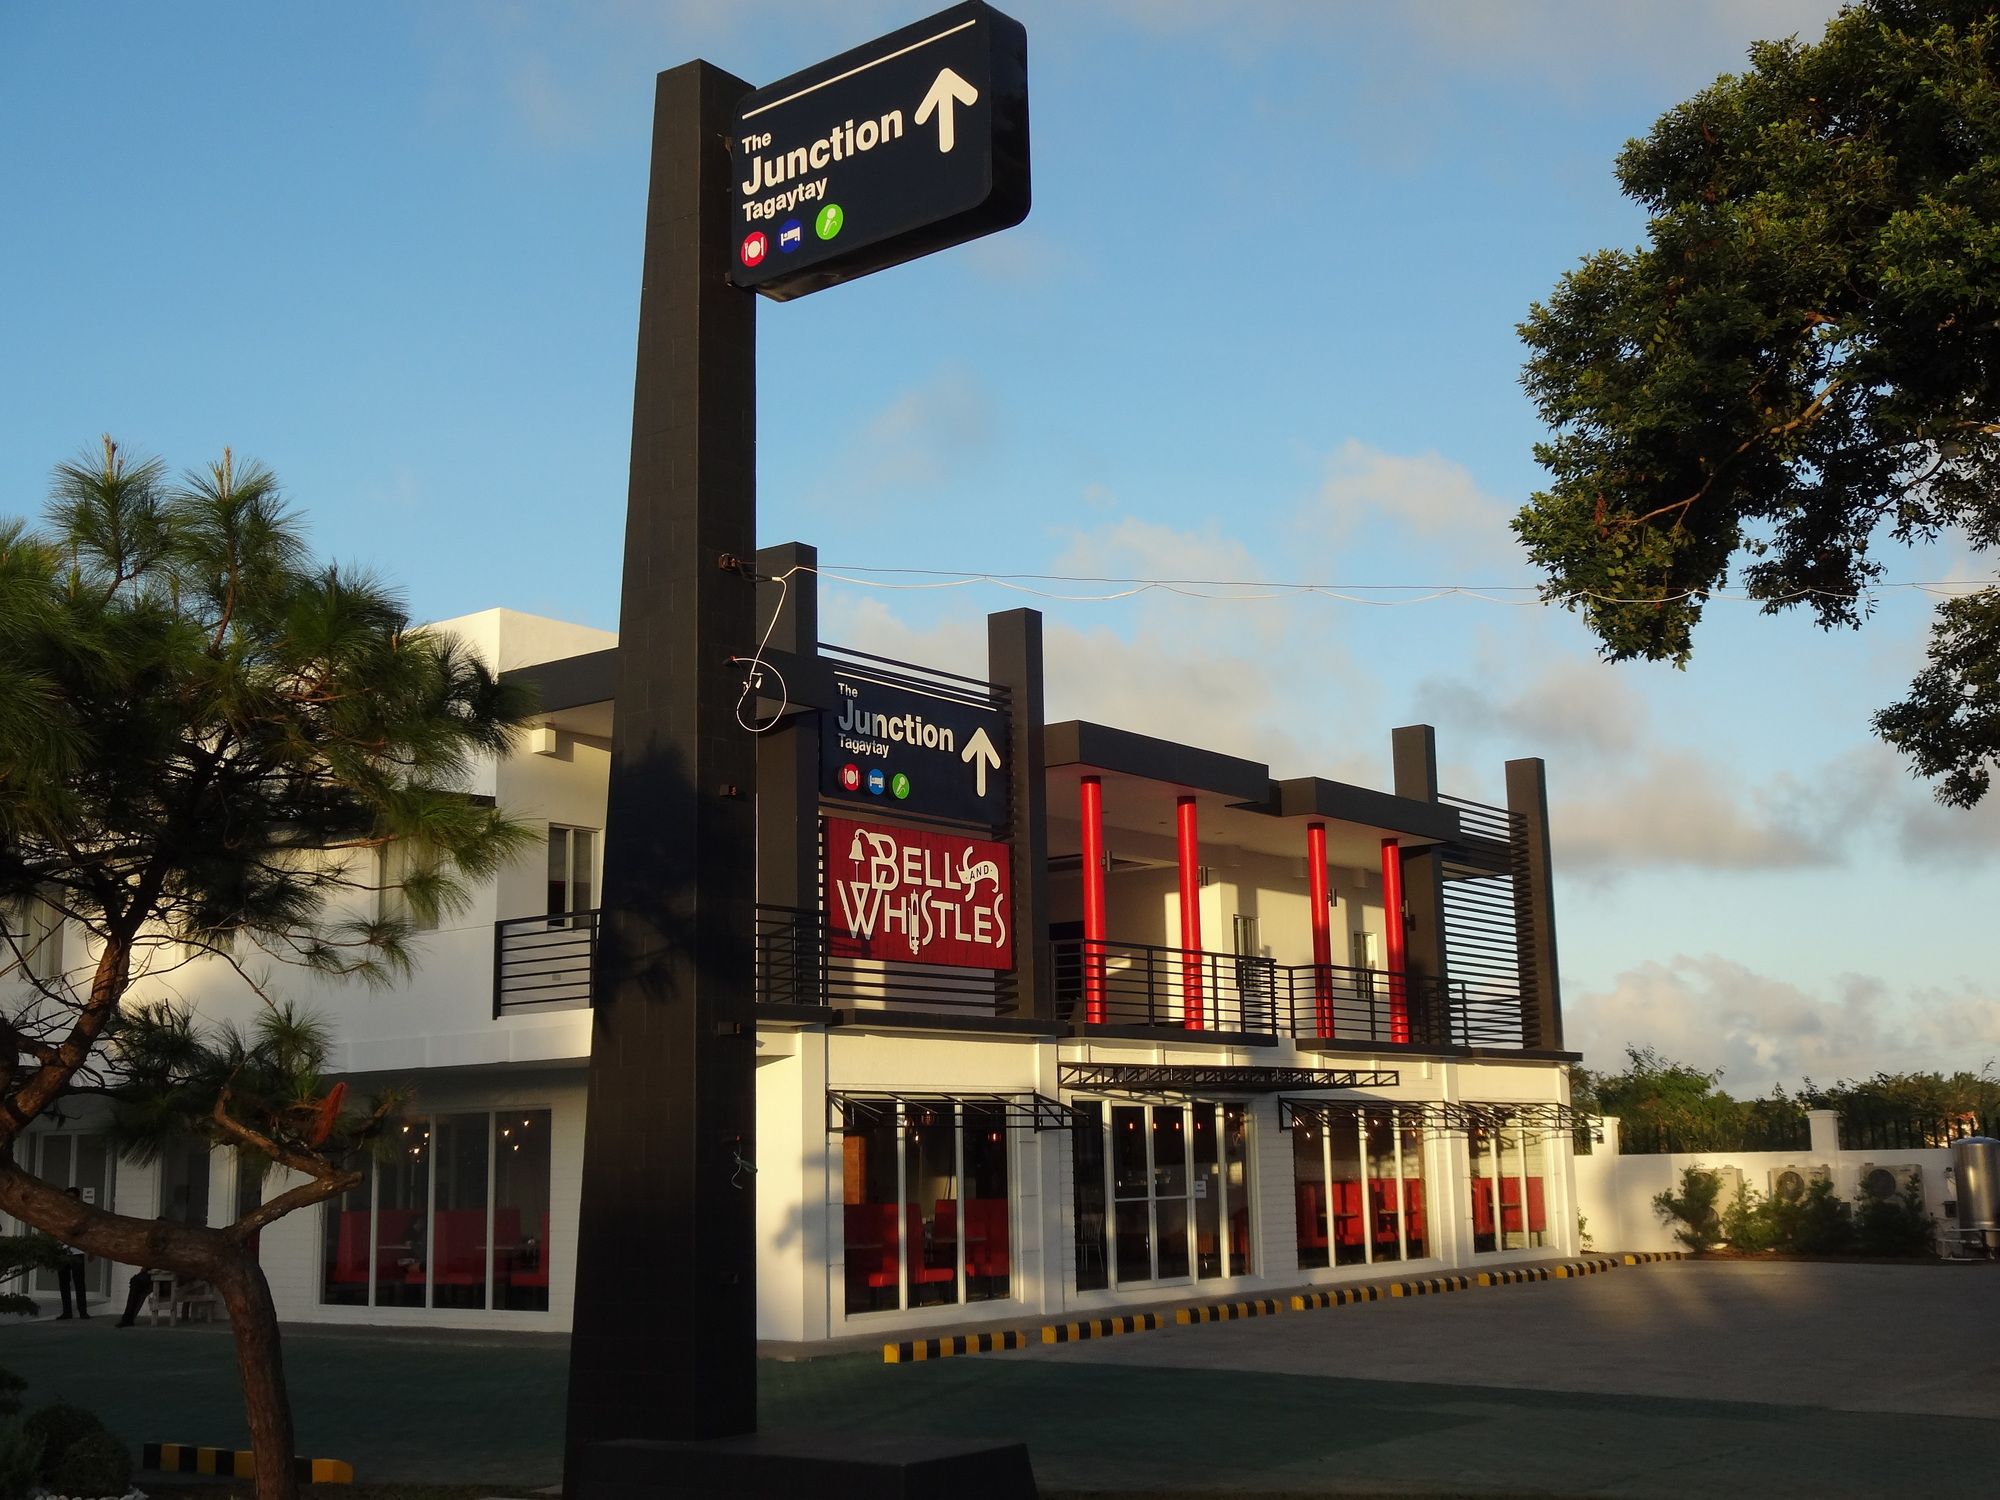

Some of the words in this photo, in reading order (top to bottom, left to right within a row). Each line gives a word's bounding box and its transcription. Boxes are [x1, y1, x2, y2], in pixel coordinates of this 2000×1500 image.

[742, 132, 772, 154] The
[742, 109, 903, 195] Junction
[742, 177, 828, 222] Tagaytay
[837, 682, 858, 698] The
[838, 699, 954, 752] Junction
[838, 732, 889, 758] Tagaytay
[849, 829, 976, 902] BELLS
[969, 864, 990, 882] AND
[837, 871, 1006, 955] WHISTLES
